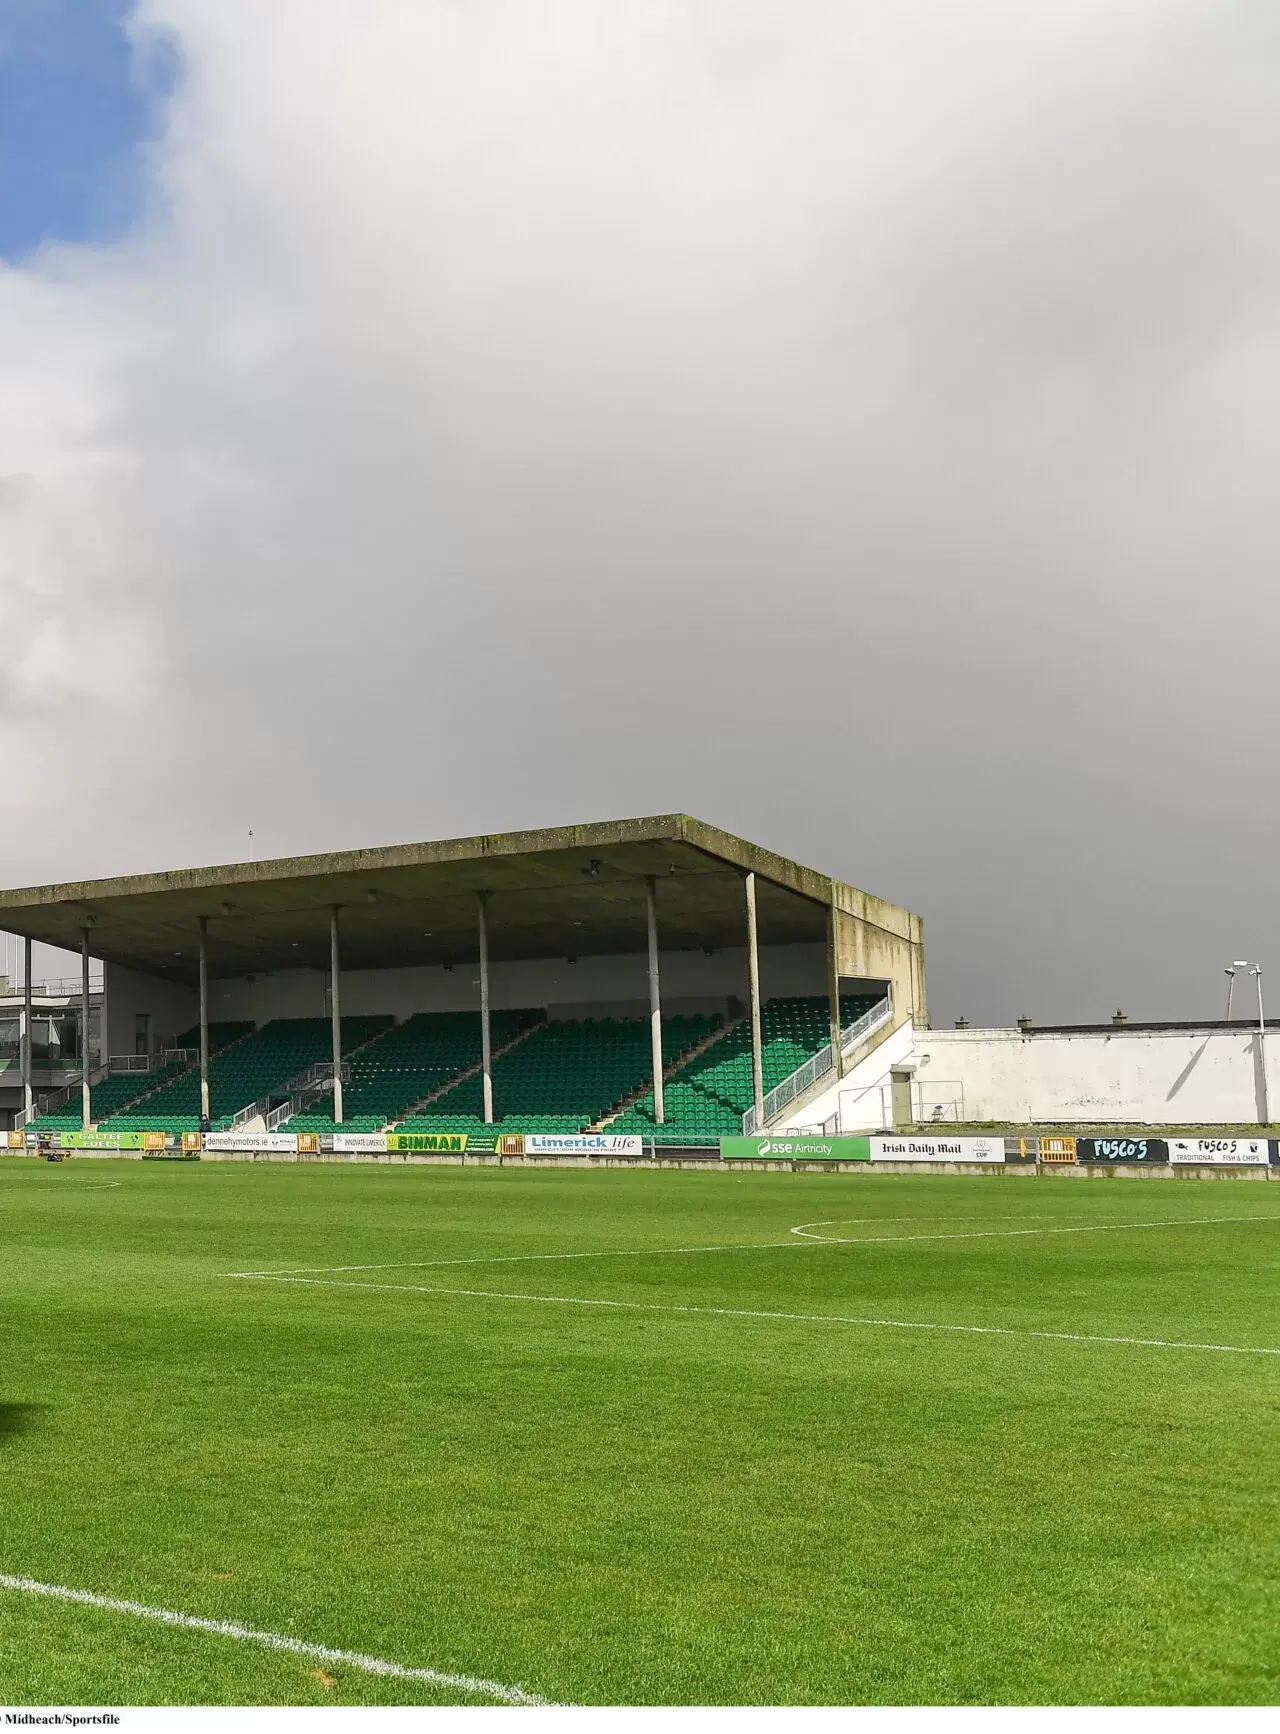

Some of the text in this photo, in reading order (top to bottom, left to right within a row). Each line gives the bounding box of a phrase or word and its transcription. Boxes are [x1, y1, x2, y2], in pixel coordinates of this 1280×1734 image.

[207, 1136, 268, 1147] dennehymotors.ie
[344, 1138, 386, 1147] INNOVATE LIMERICK
[398, 1136, 461, 1150] BINMAN
[531, 1136, 635, 1150] Limerick life
[771, 1143, 832, 1156] sse Airtricity
[881, 1143, 962, 1156] Irish Daily Mail
[1094, 1140, 1148, 1160] FUSCO'S
[1242, 1154, 1260, 1162] CHIPS
